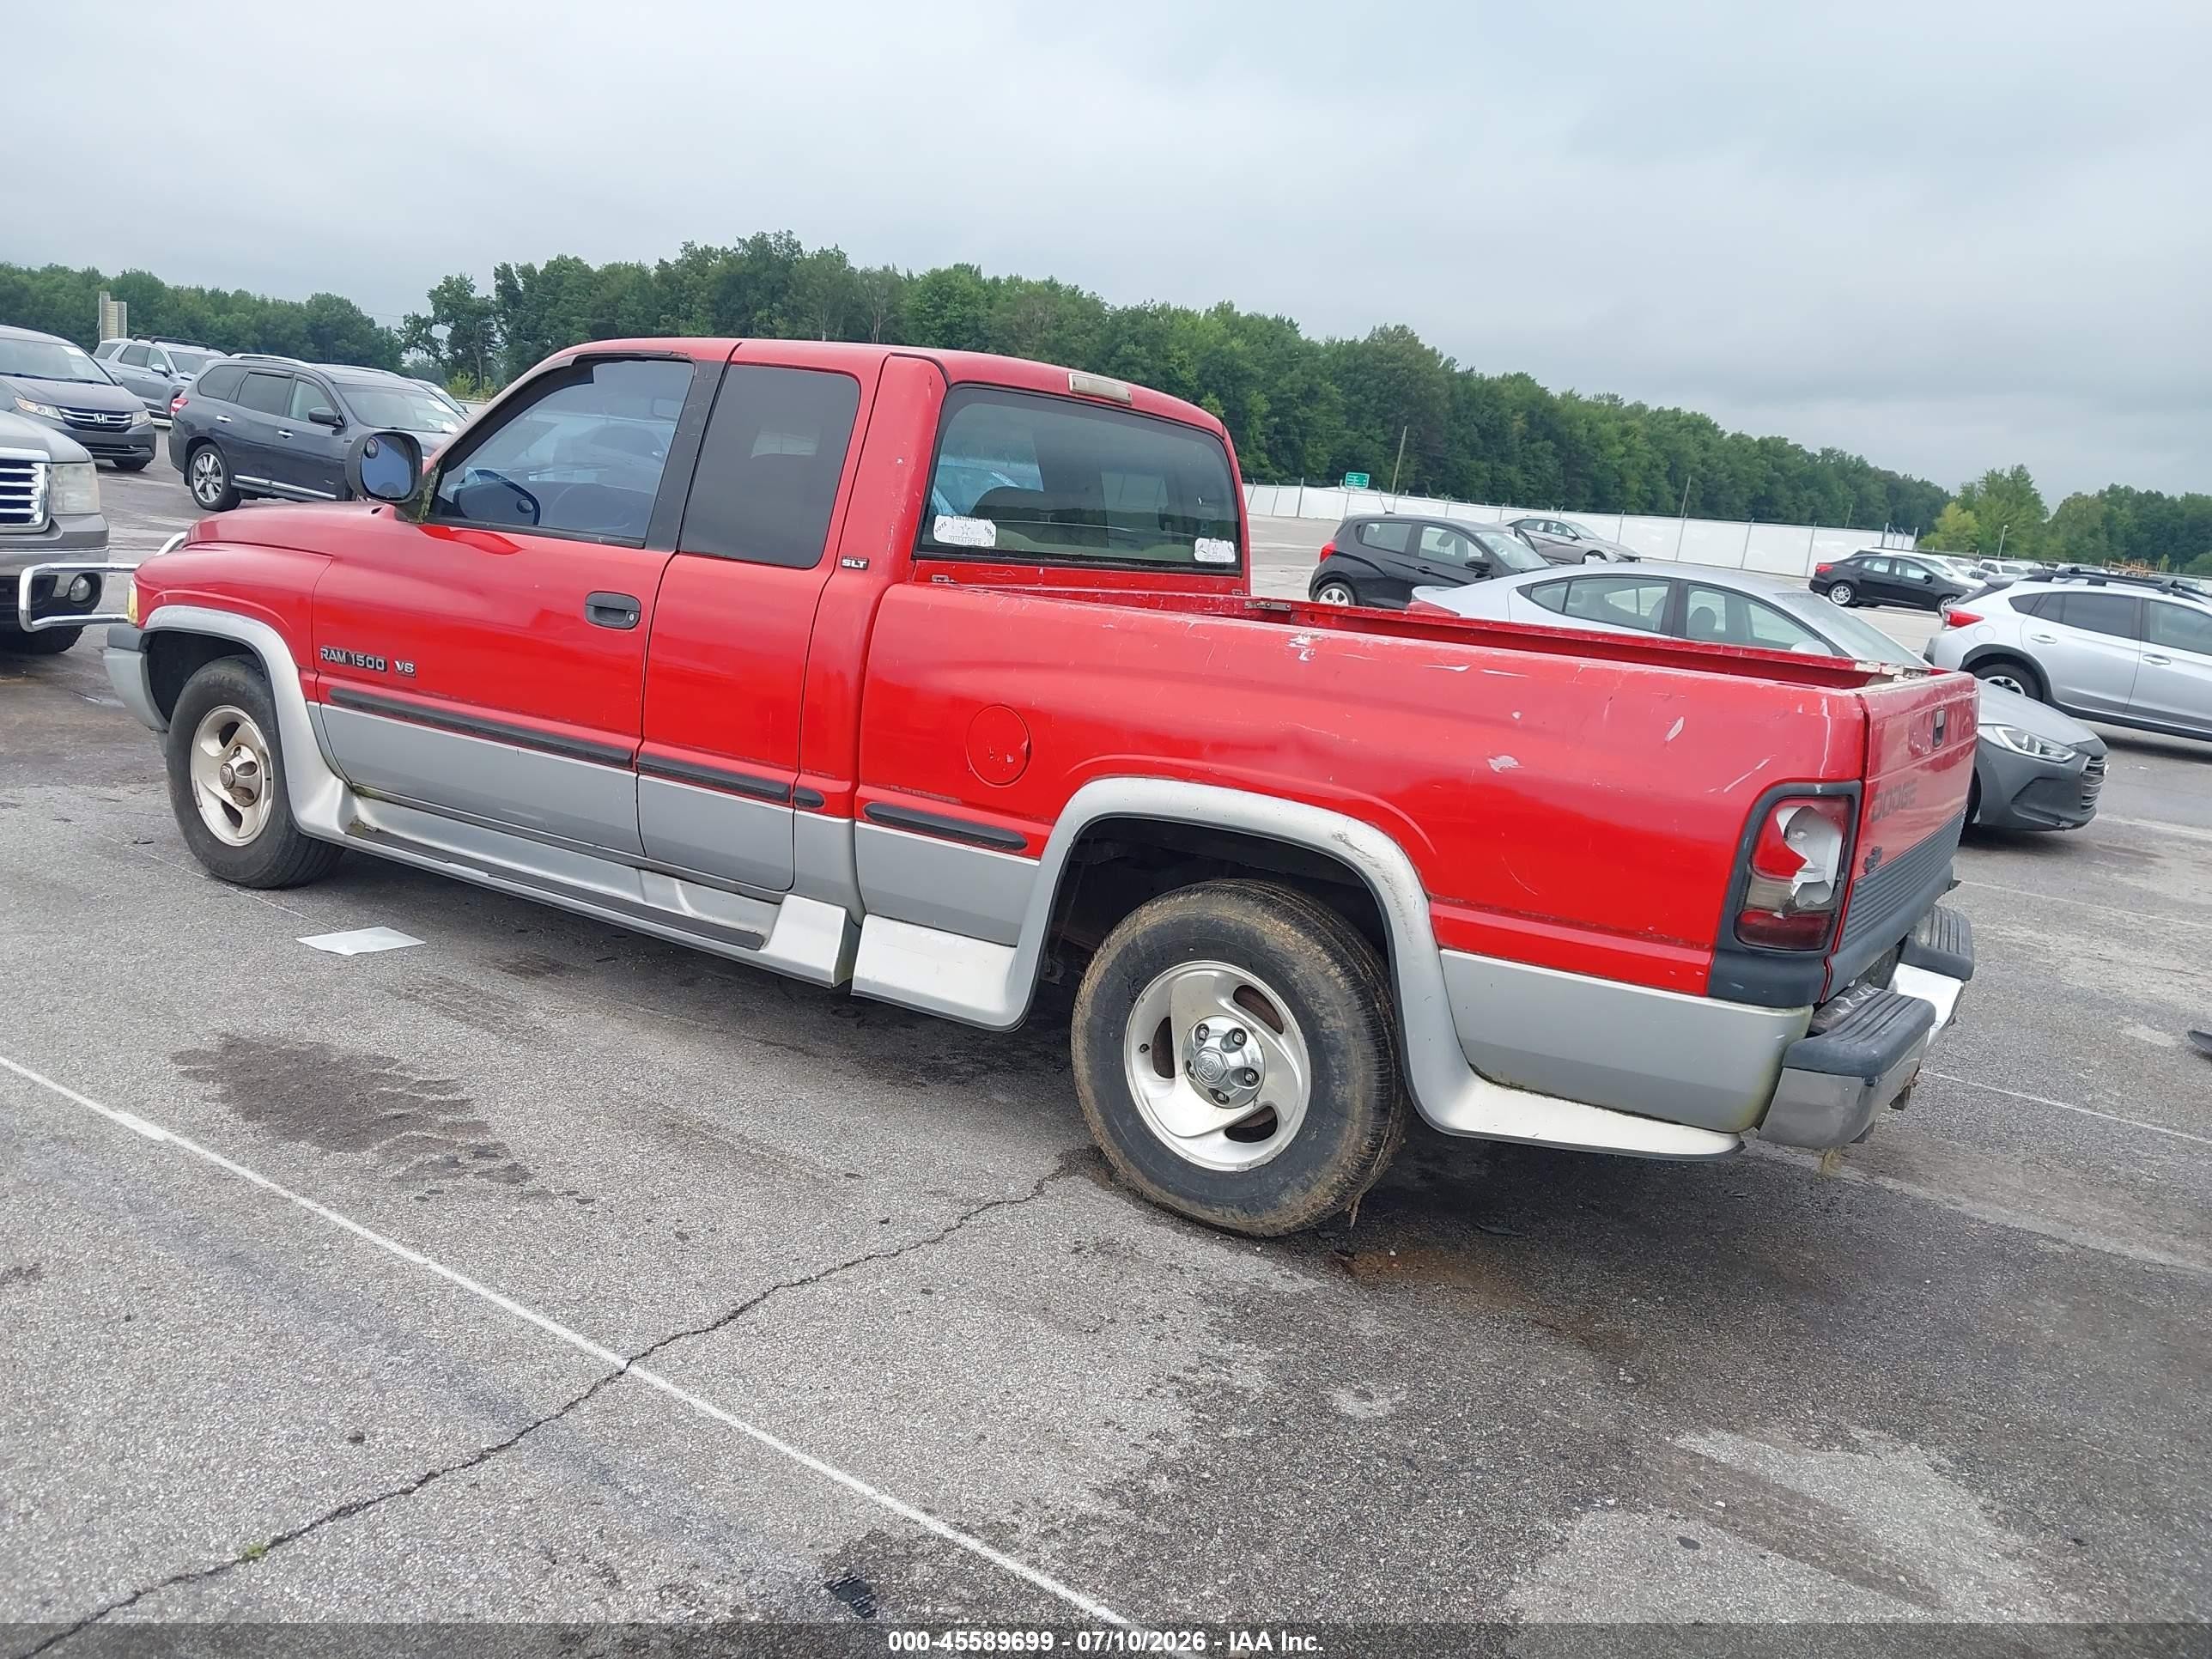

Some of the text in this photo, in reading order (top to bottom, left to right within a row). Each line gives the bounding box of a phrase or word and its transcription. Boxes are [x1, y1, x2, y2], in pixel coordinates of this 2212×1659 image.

[842, 558, 867, 568] SLT
[319, 647, 346, 664] RAM
[350, 653, 386, 672] 1500
[1869, 776, 1918, 823] DODGE
